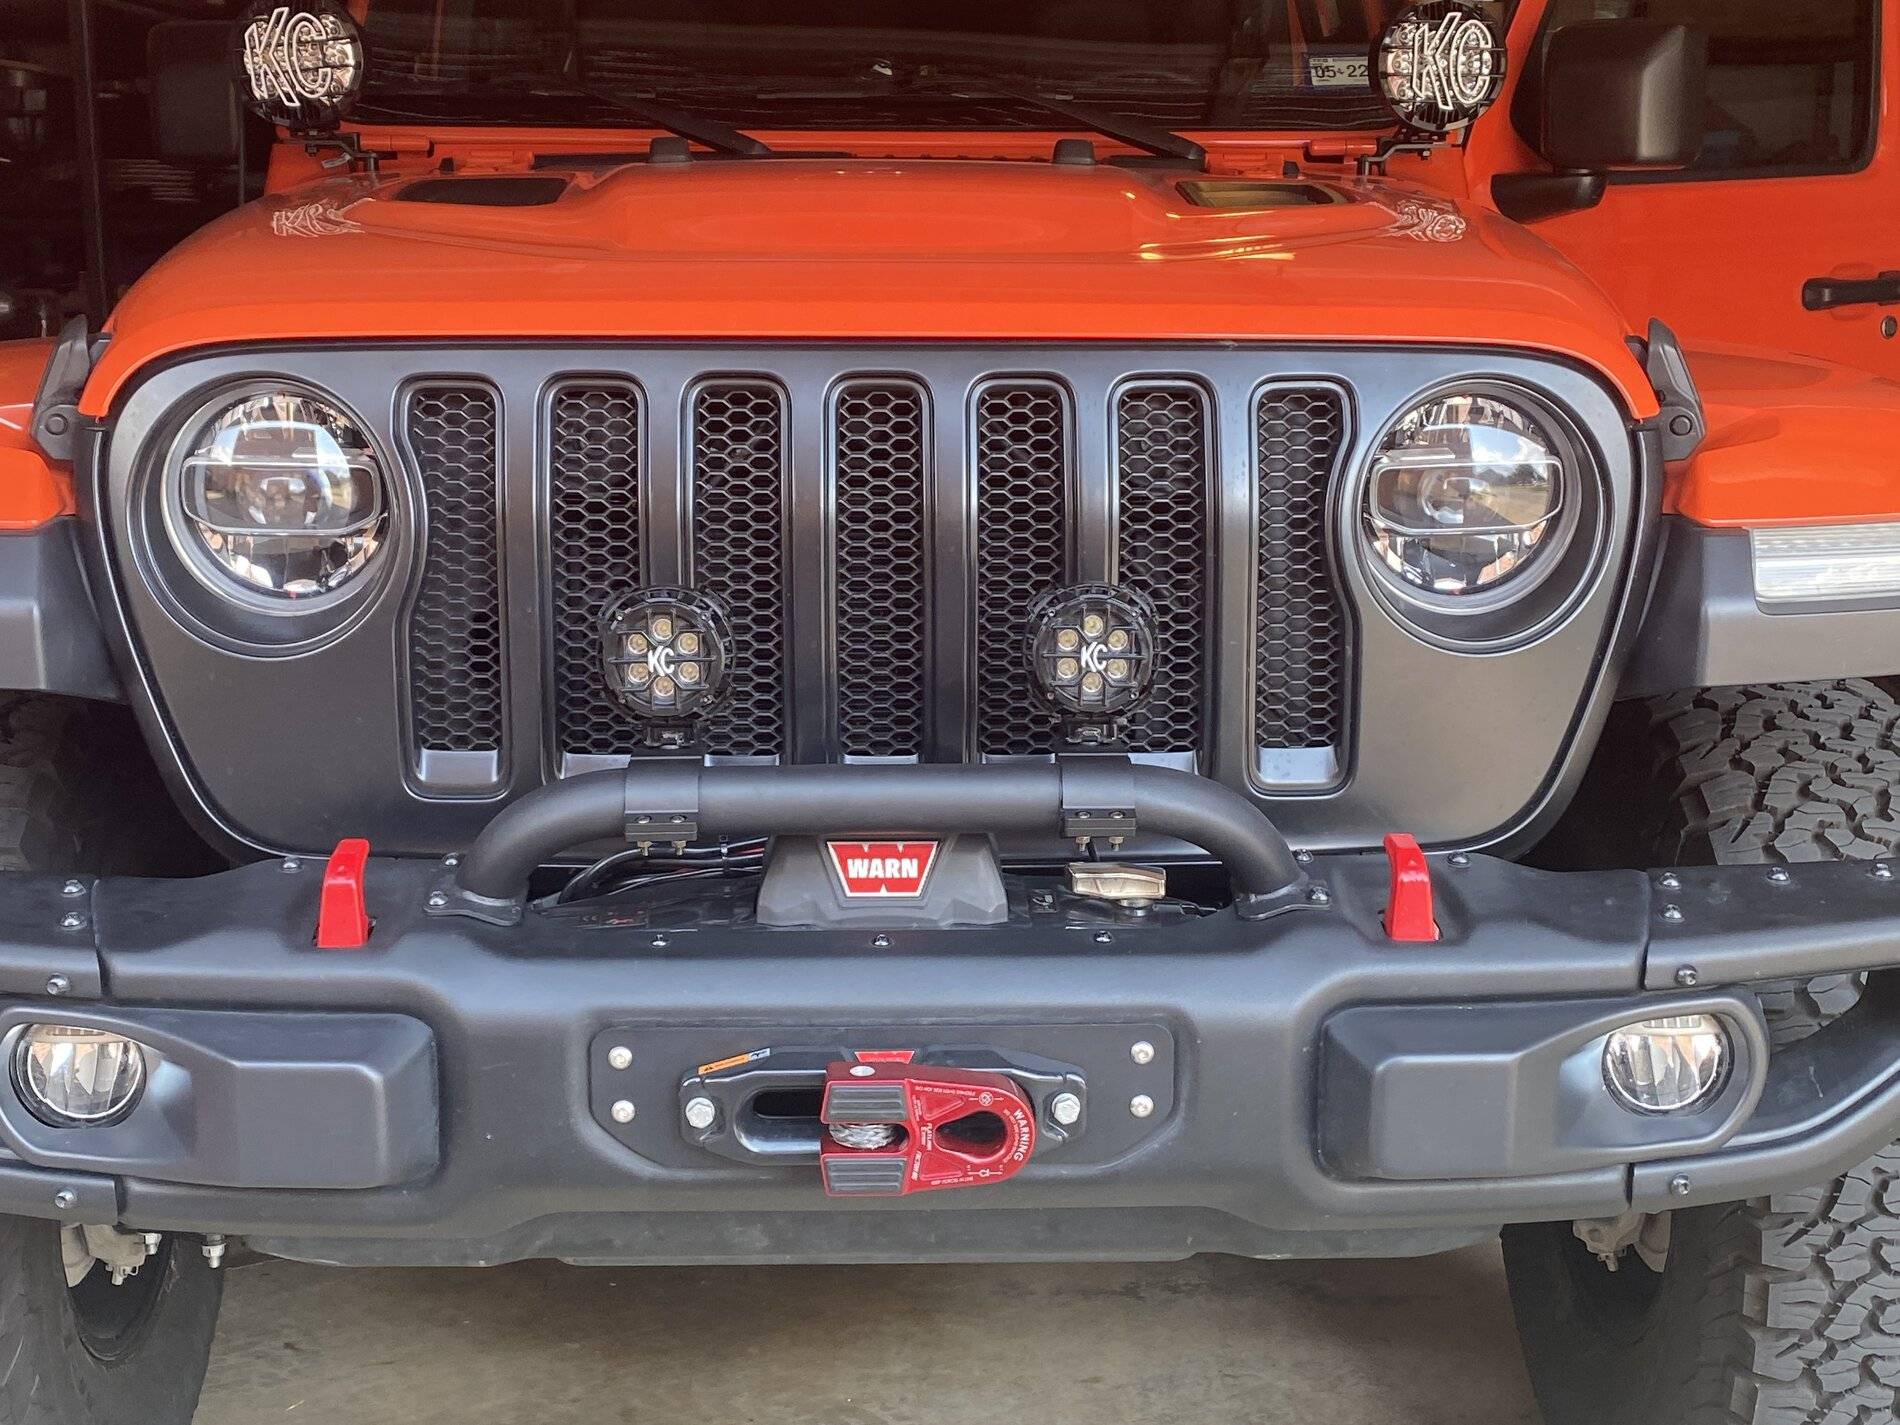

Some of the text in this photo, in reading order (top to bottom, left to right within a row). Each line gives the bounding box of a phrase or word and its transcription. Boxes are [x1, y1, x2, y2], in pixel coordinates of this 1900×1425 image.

[245, 7, 332, 107] KC
[1412, 12, 1492, 110] KC
[648, 645, 675, 676] KC
[1081, 641, 1108, 672] KC
[847, 858, 919, 878] WARN
[1012, 1108, 1030, 1162] WARNING
